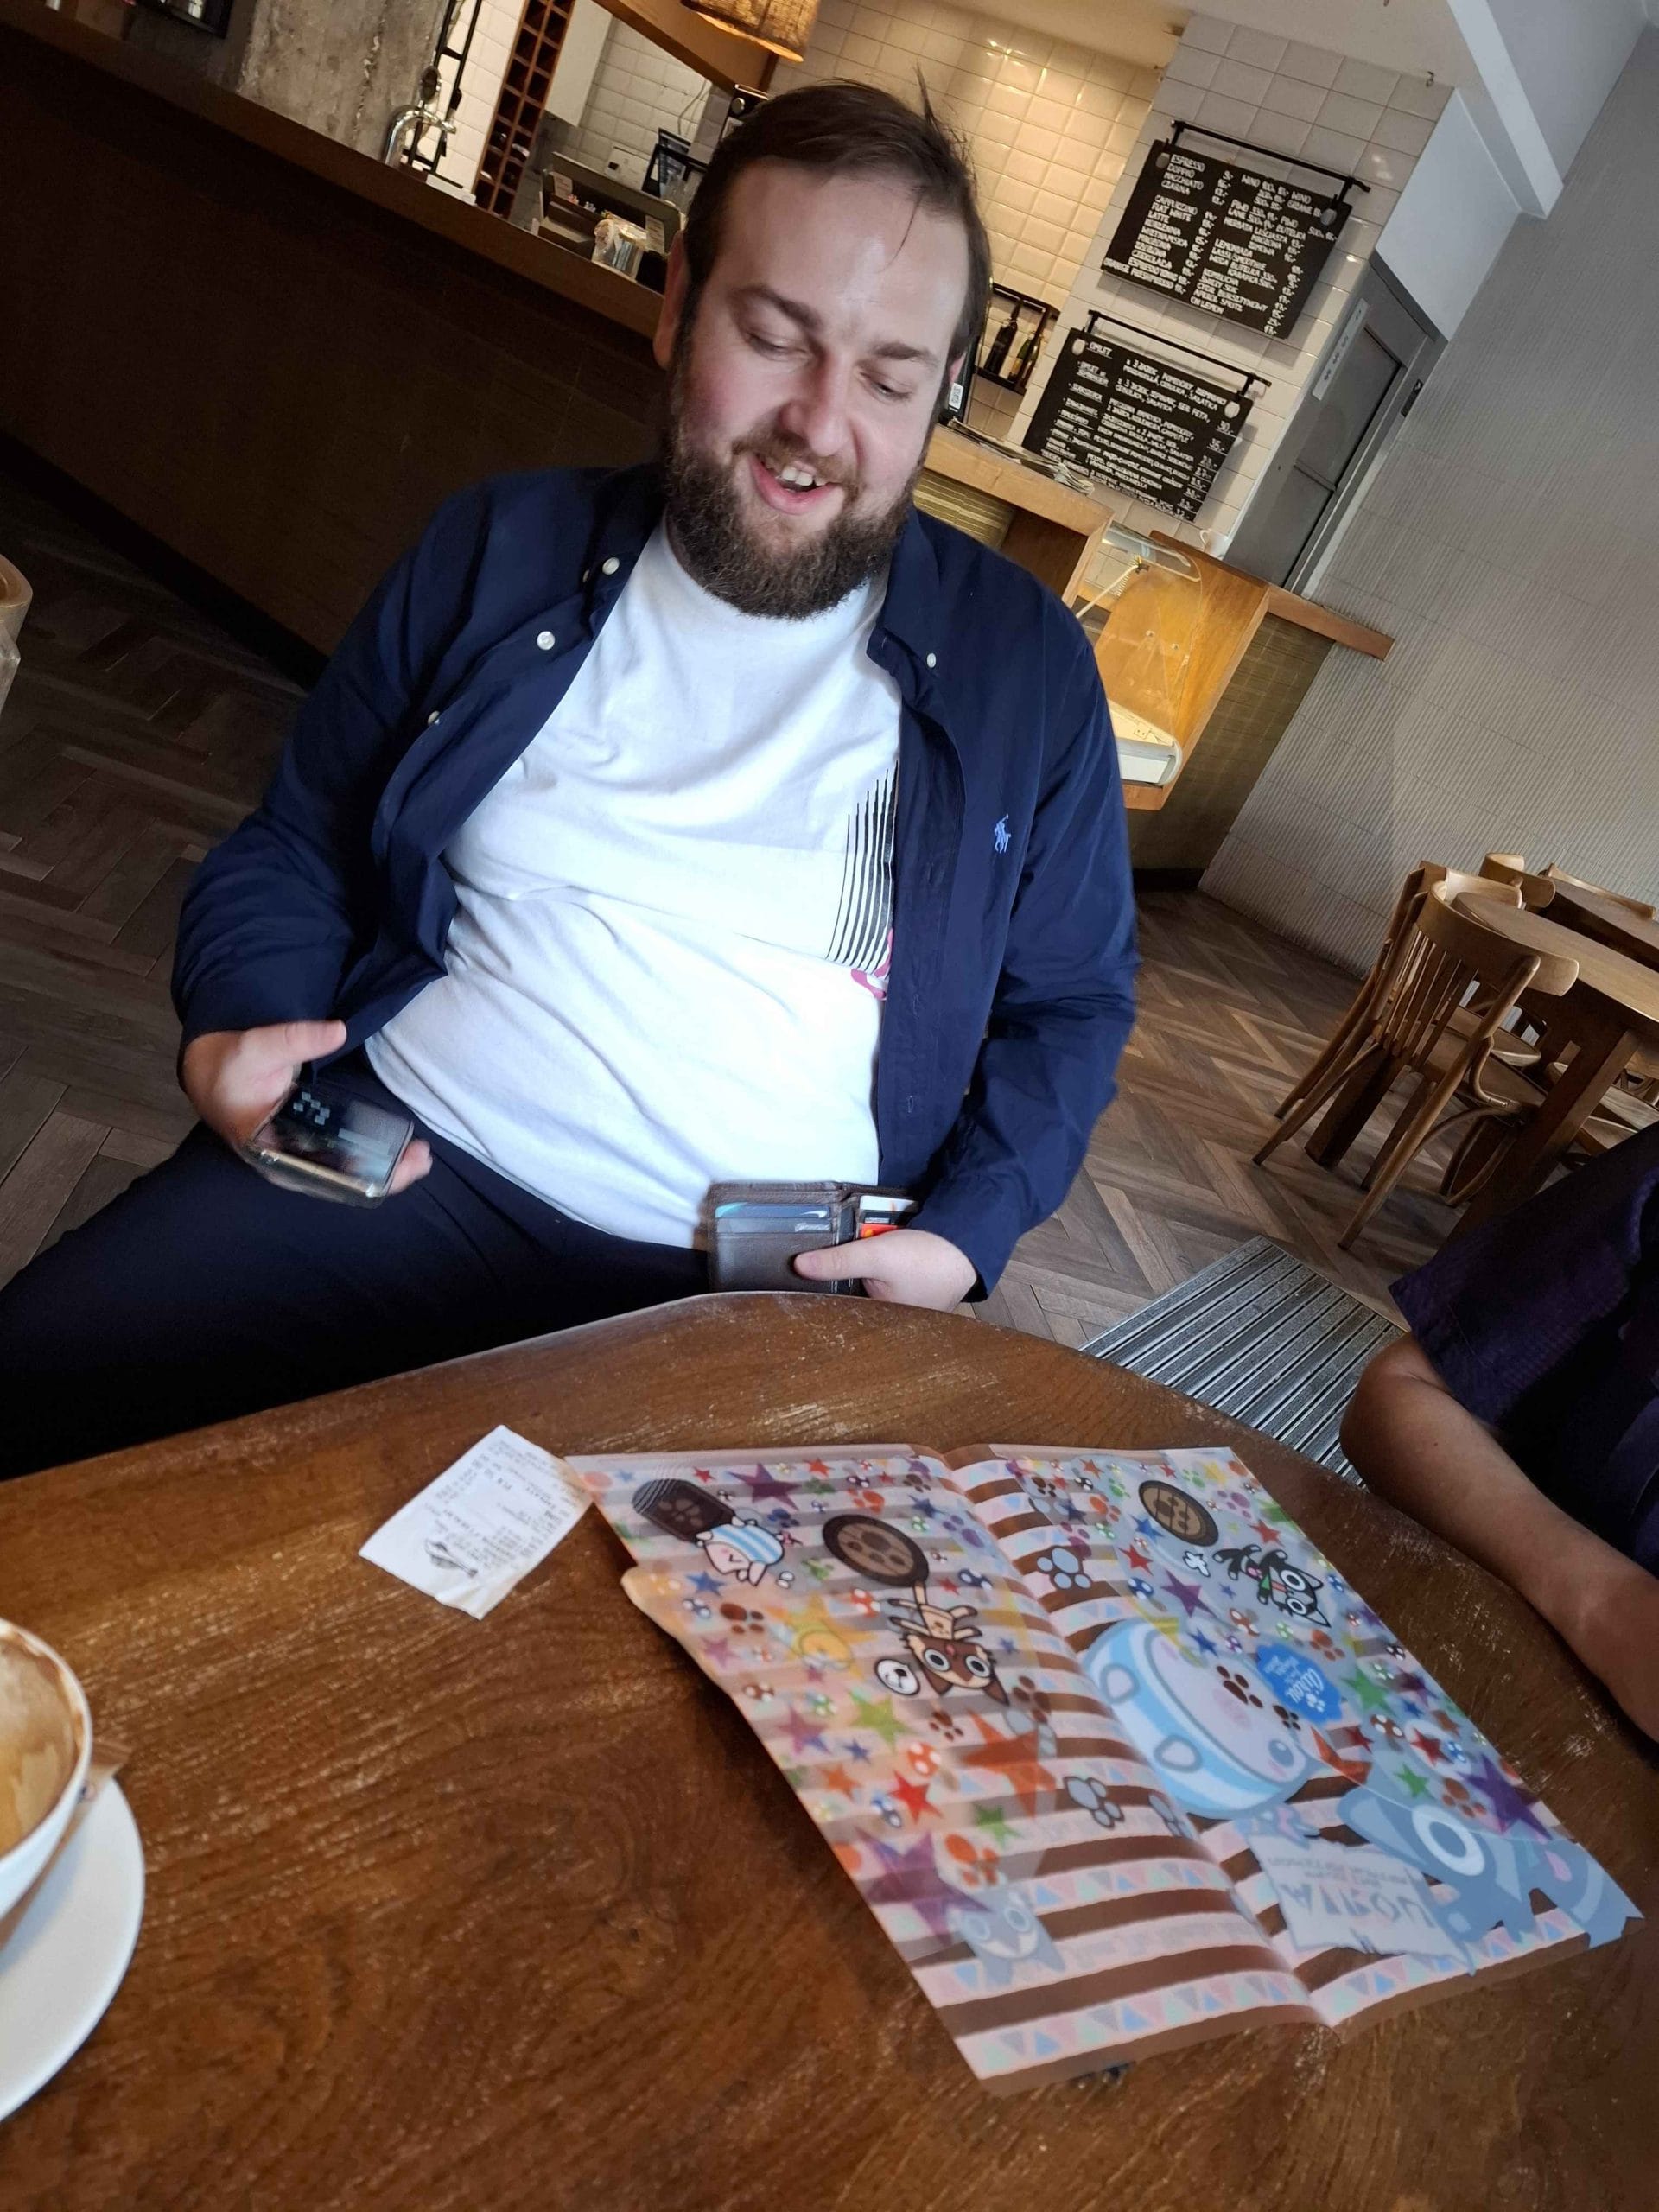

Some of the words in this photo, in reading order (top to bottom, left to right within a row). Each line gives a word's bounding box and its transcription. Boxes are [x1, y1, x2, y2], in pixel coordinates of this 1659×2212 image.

[1166, 162, 1195, 179] DOPPIO
[1170, 154, 1205, 172] ESPRESSO
[1163, 171, 1204, 190] MACCHIATO
[1241, 174, 1261, 188] WINO
[1154, 194, 1198, 216] CAPPUCCINO
[1291, 191, 1312, 205] WINO
[1151, 201, 1170, 214] FLAT
[1168, 207, 1192, 222] WHITE
[1230, 199, 1249, 213] PIWO
[1147, 209, 1171, 224] LATTE
[1280, 215, 1298, 228] PIWO
[1214, 238, 1254, 258] LEMONIADA
[1127, 256, 1162, 276] ESPRESSO
[1192, 289, 1218, 303] APEROL
[1199, 300, 1224, 315] LEMON
[1089, 341, 1113, 356] OMLET
